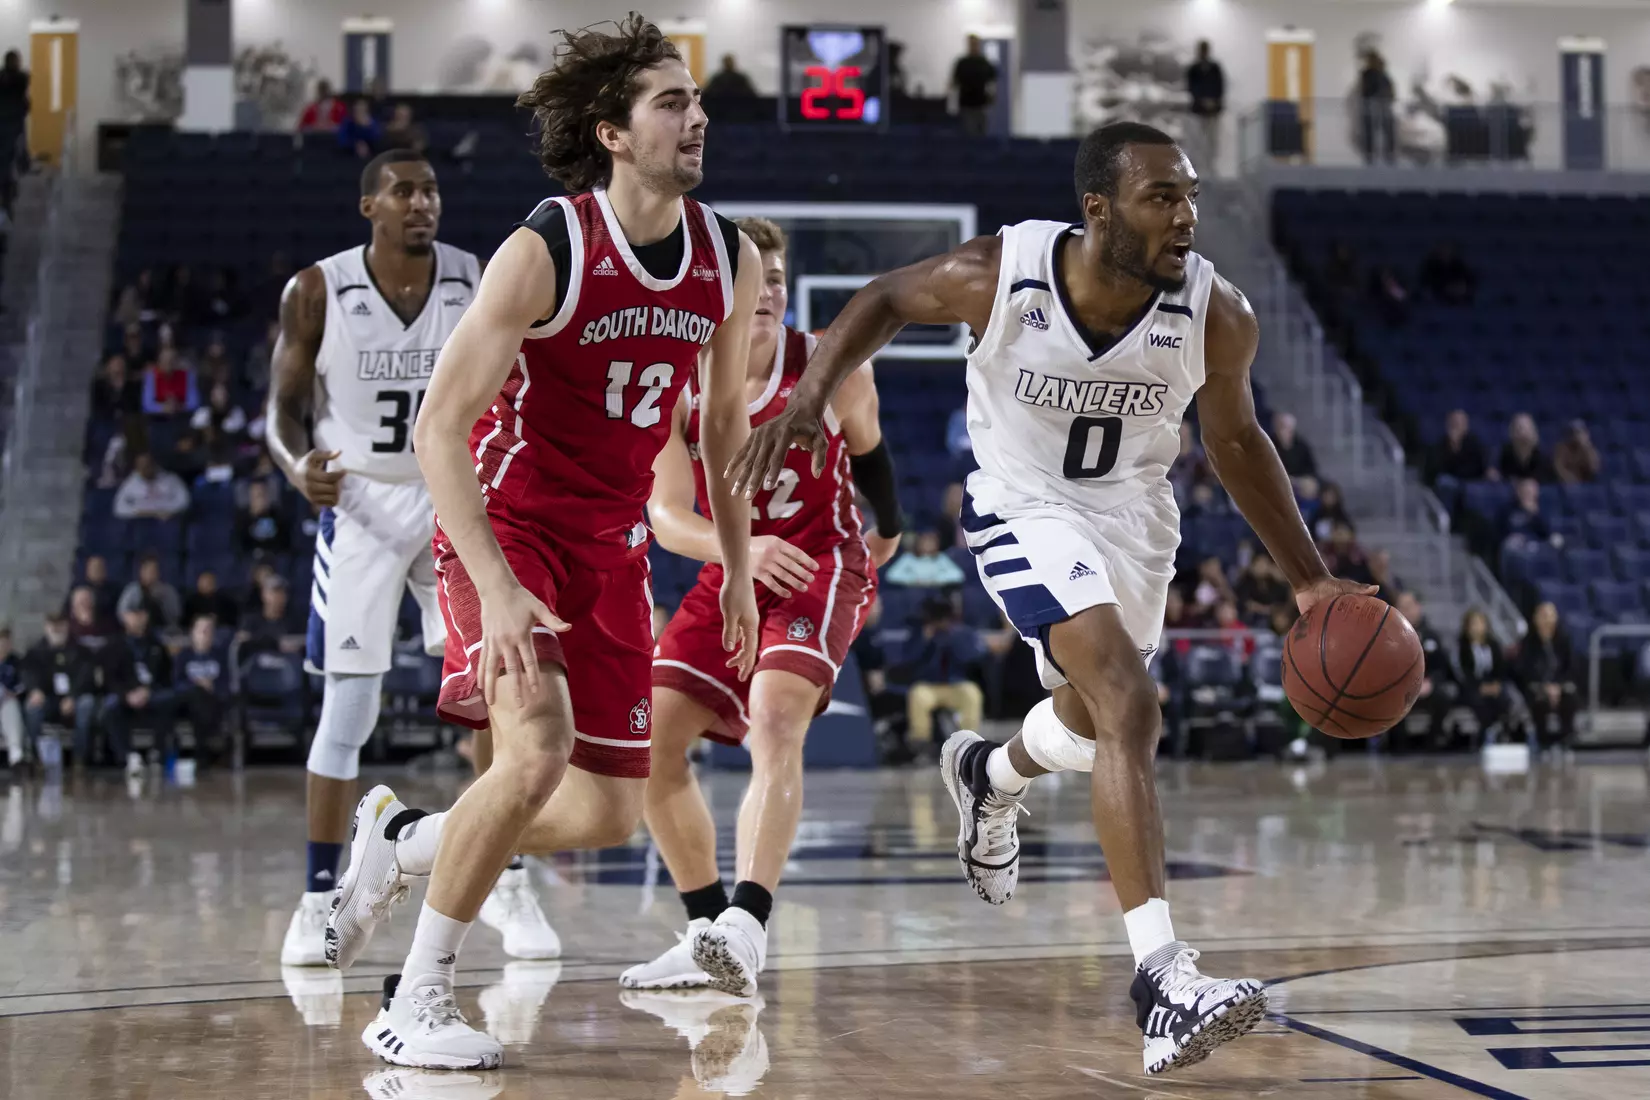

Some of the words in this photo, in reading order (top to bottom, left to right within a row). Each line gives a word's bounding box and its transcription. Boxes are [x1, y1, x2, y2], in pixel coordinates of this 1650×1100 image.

[801, 66, 865, 120] 25
[592, 268, 619, 277] adidas
[578, 306, 649, 346] SOUTH
[1020, 316, 1049, 331] adidas
[1149, 333, 1183, 349] WAC
[358, 347, 443, 381] LANCE
[605, 360, 675, 428] 12
[1014, 368, 1169, 417] LANCERS
[371, 388, 427, 453] 3
[1062, 415, 1123, 479] 0
[751, 467, 804, 520] 2
[1069, 569, 1098, 581] adidas
